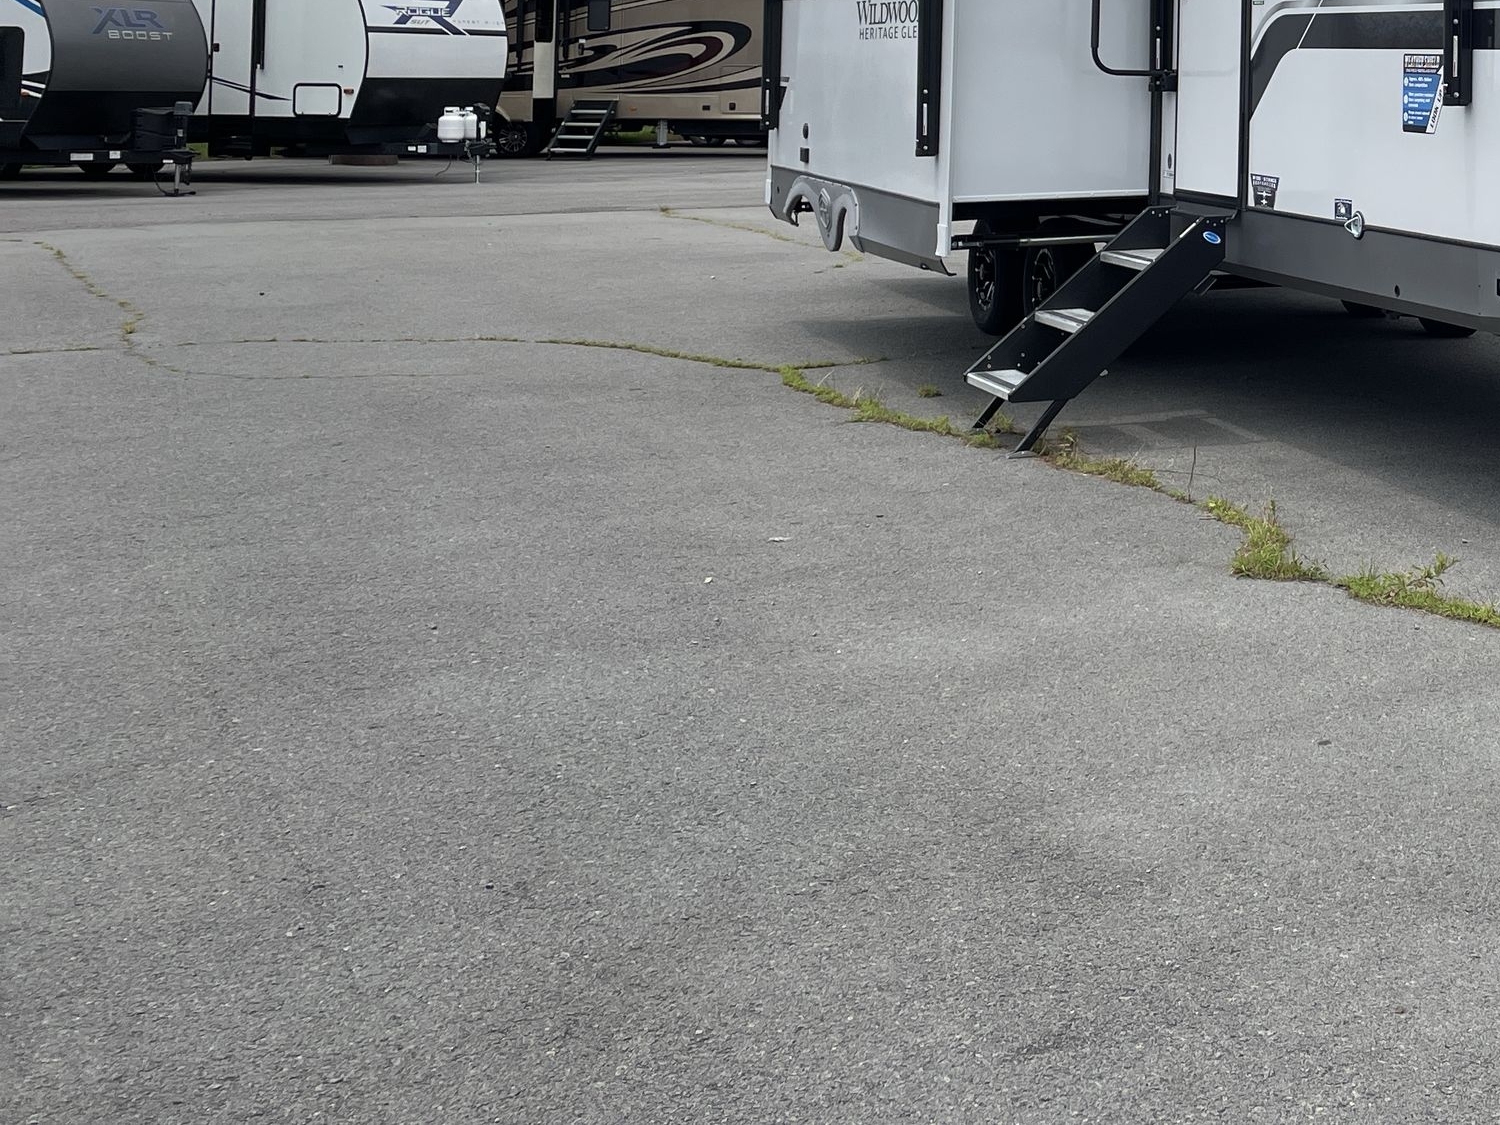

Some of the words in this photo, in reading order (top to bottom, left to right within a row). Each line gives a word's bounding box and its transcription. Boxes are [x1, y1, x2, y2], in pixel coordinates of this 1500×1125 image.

[396, 7, 451, 17] ROGUE
[856, 0, 919, 25] WILDWOO
[90, 6, 164, 35] XLR
[107, 29, 174, 42] BOOST
[859, 26, 899, 41] HERITAGE
[901, 25, 918, 39] GLE
